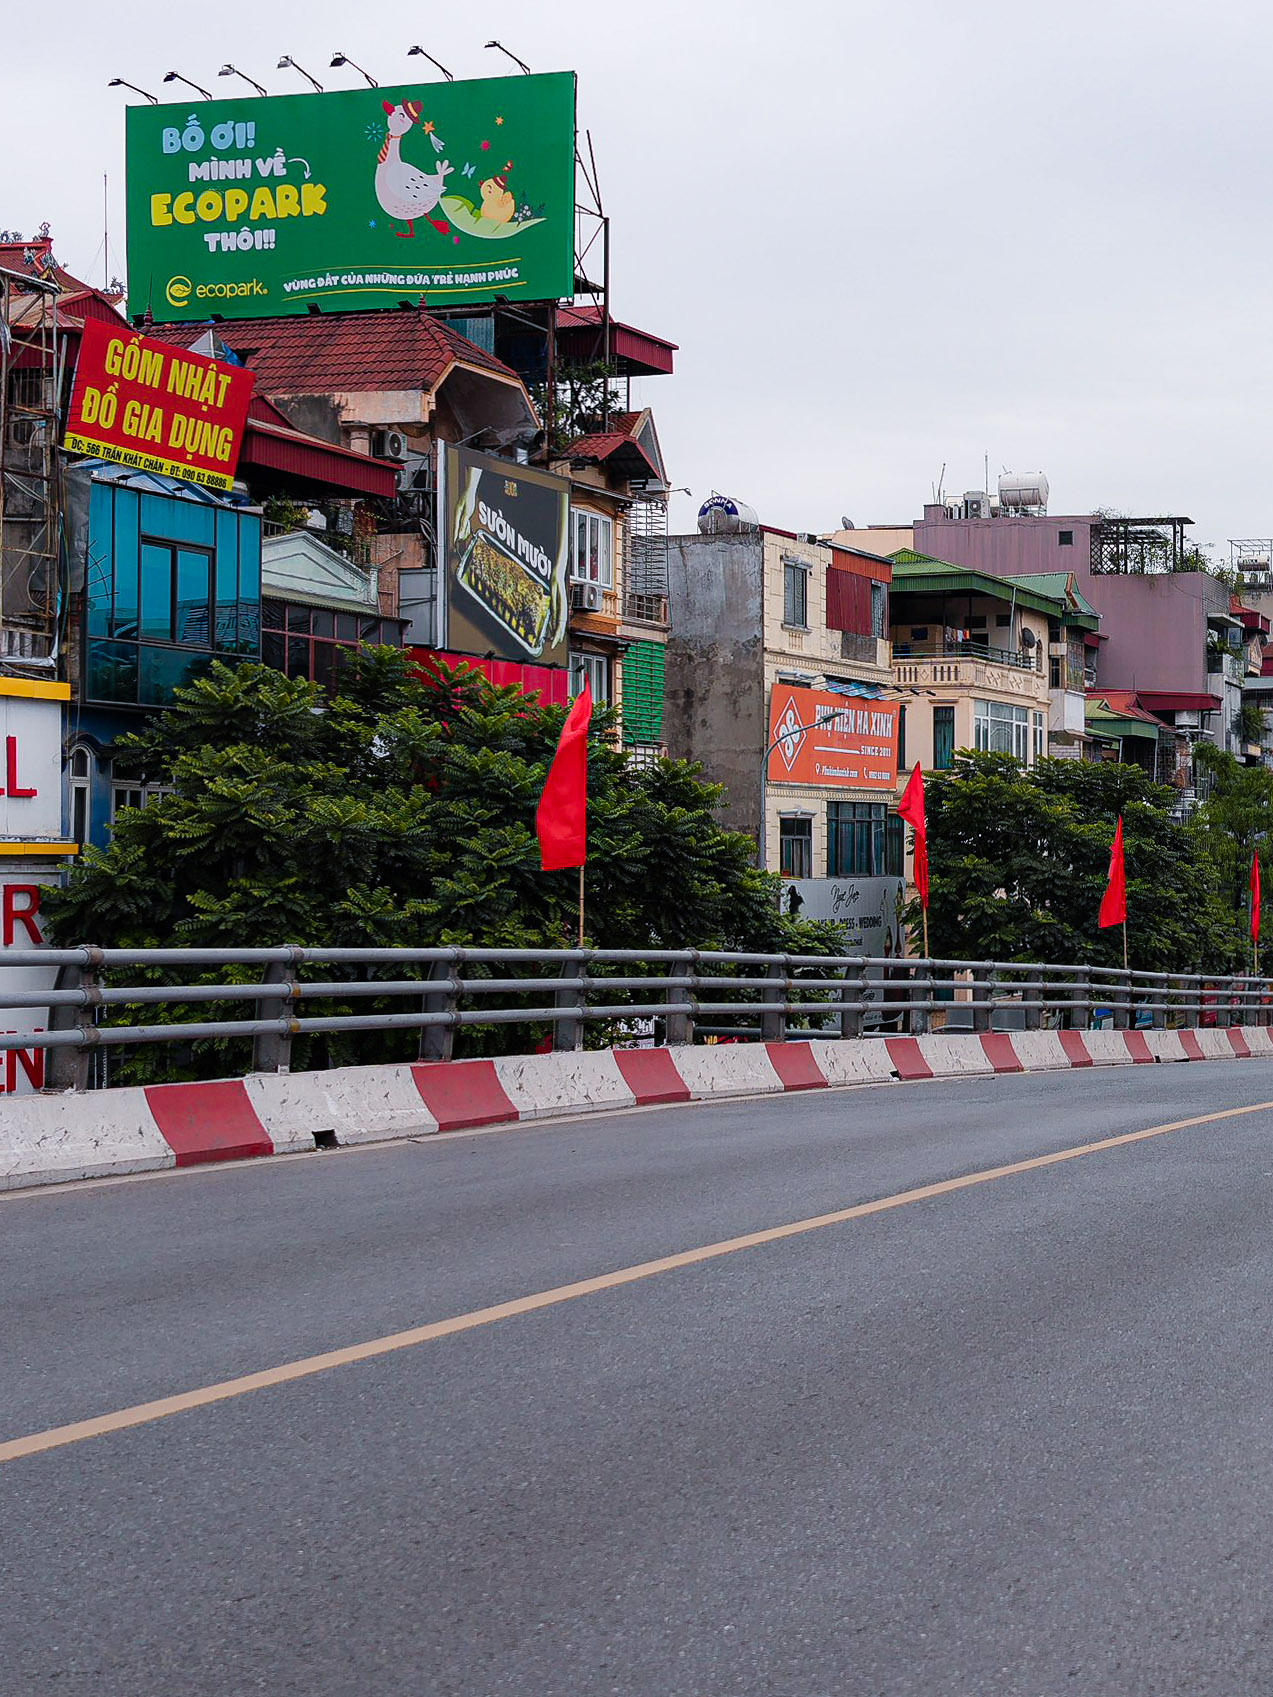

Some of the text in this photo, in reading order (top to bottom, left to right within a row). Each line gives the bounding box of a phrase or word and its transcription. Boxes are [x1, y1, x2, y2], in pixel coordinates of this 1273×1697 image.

[162, 113, 256, 154] BỐ ƠI!
[188, 147, 286, 182] MÌNH VỀ
[150, 183, 327, 227] ECOPARK
[204, 227, 276, 252] THÔI!!
[196, 279, 264, 299] ecopark
[283, 267, 519, 292] VÙNG ĐẤT CỦA NHỮNG ĐỨA TRẺ HẠNH PHÚC
[104, 334, 232, 412] GỐM NHẬT
[80, 381, 234, 462] ĐỒ GIA DỤNG
[86, 442, 100, 455] 566
[182, 468, 195, 481] 090
[478, 500, 552, 580] SƯỜN MƯỜI
[856, 703, 869, 735] HÀ
[870, 712, 893, 738] XINH
[860, 745, 878, 756] SINCE
[859, 915, 882, 929] WEDDING
